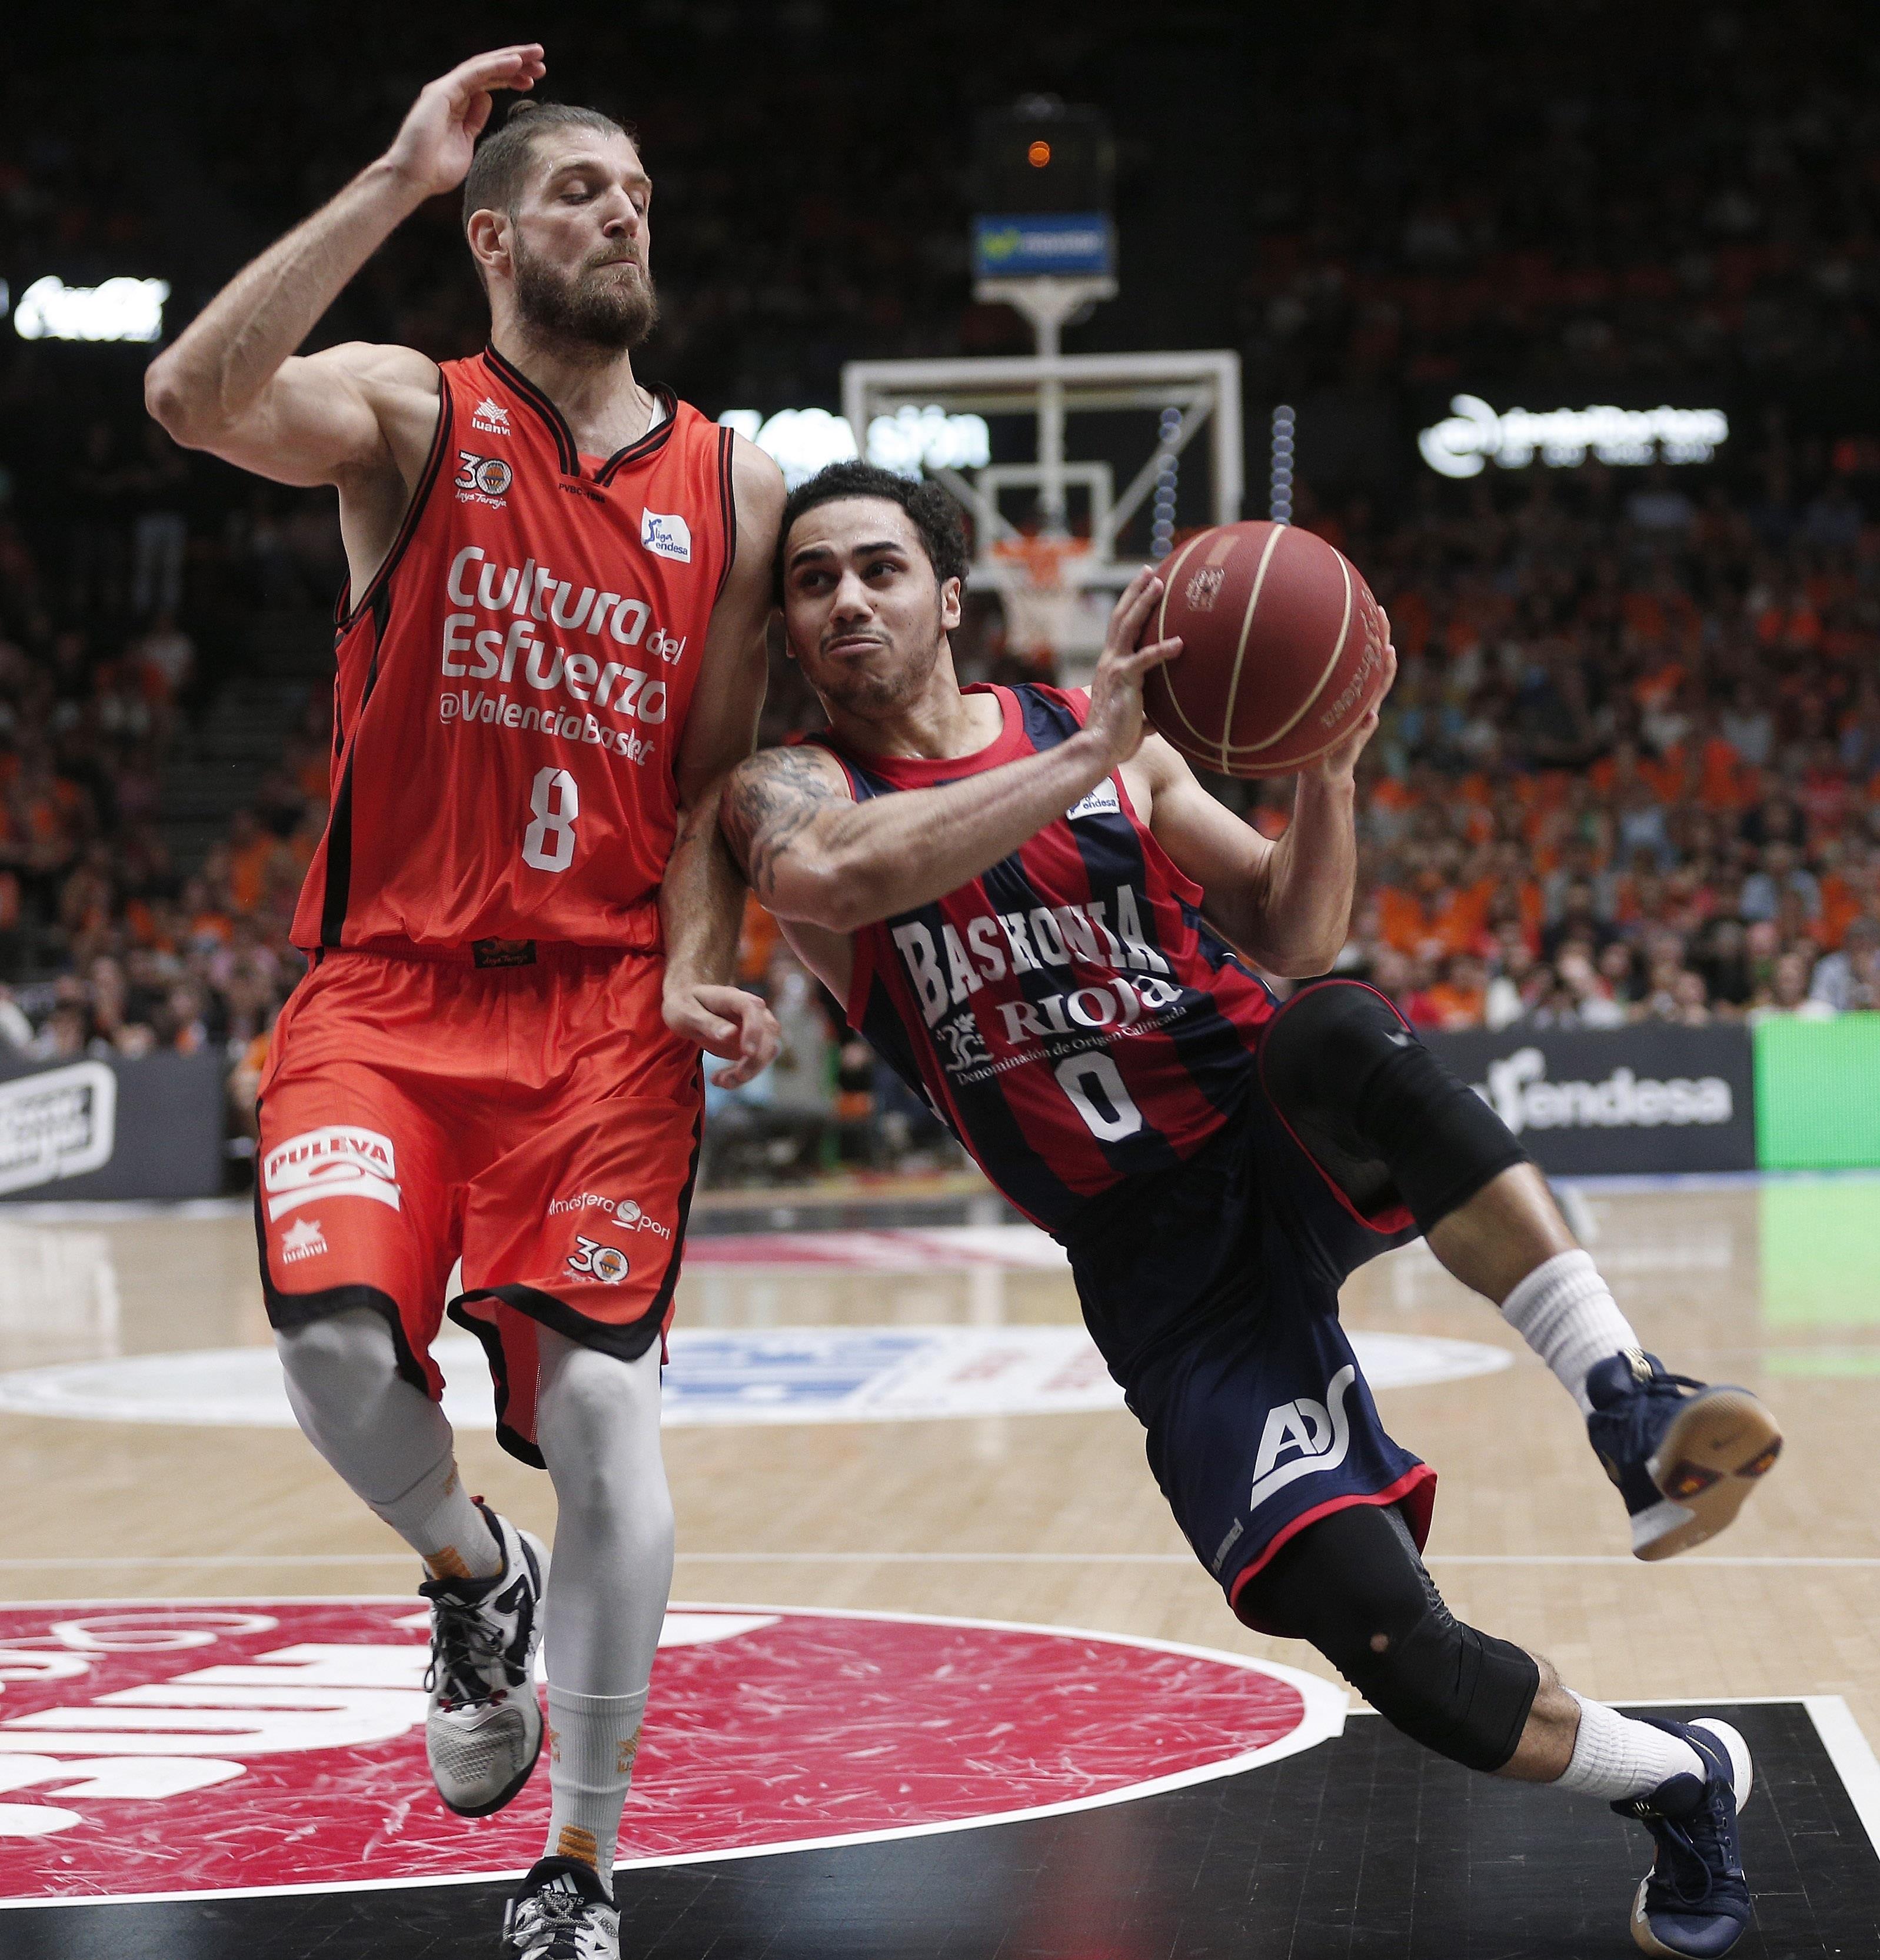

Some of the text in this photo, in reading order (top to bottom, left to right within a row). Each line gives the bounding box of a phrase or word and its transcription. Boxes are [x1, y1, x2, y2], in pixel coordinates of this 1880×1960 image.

[655, 528, 673, 543] liga
[656, 542, 688, 555] endesa
[448, 546, 687, 665] Cultura del
[442, 613, 666, 724] Esfuerzo
[521, 766, 579, 873] 8
[1083, 799, 1116, 809] endesa
[891, 884, 1170, 1029] BASKONIA
[1052, 1042, 1070, 1055] de
[1071, 1031, 1123, 1050] Origen
[1055, 1051, 1142, 1143] 0
